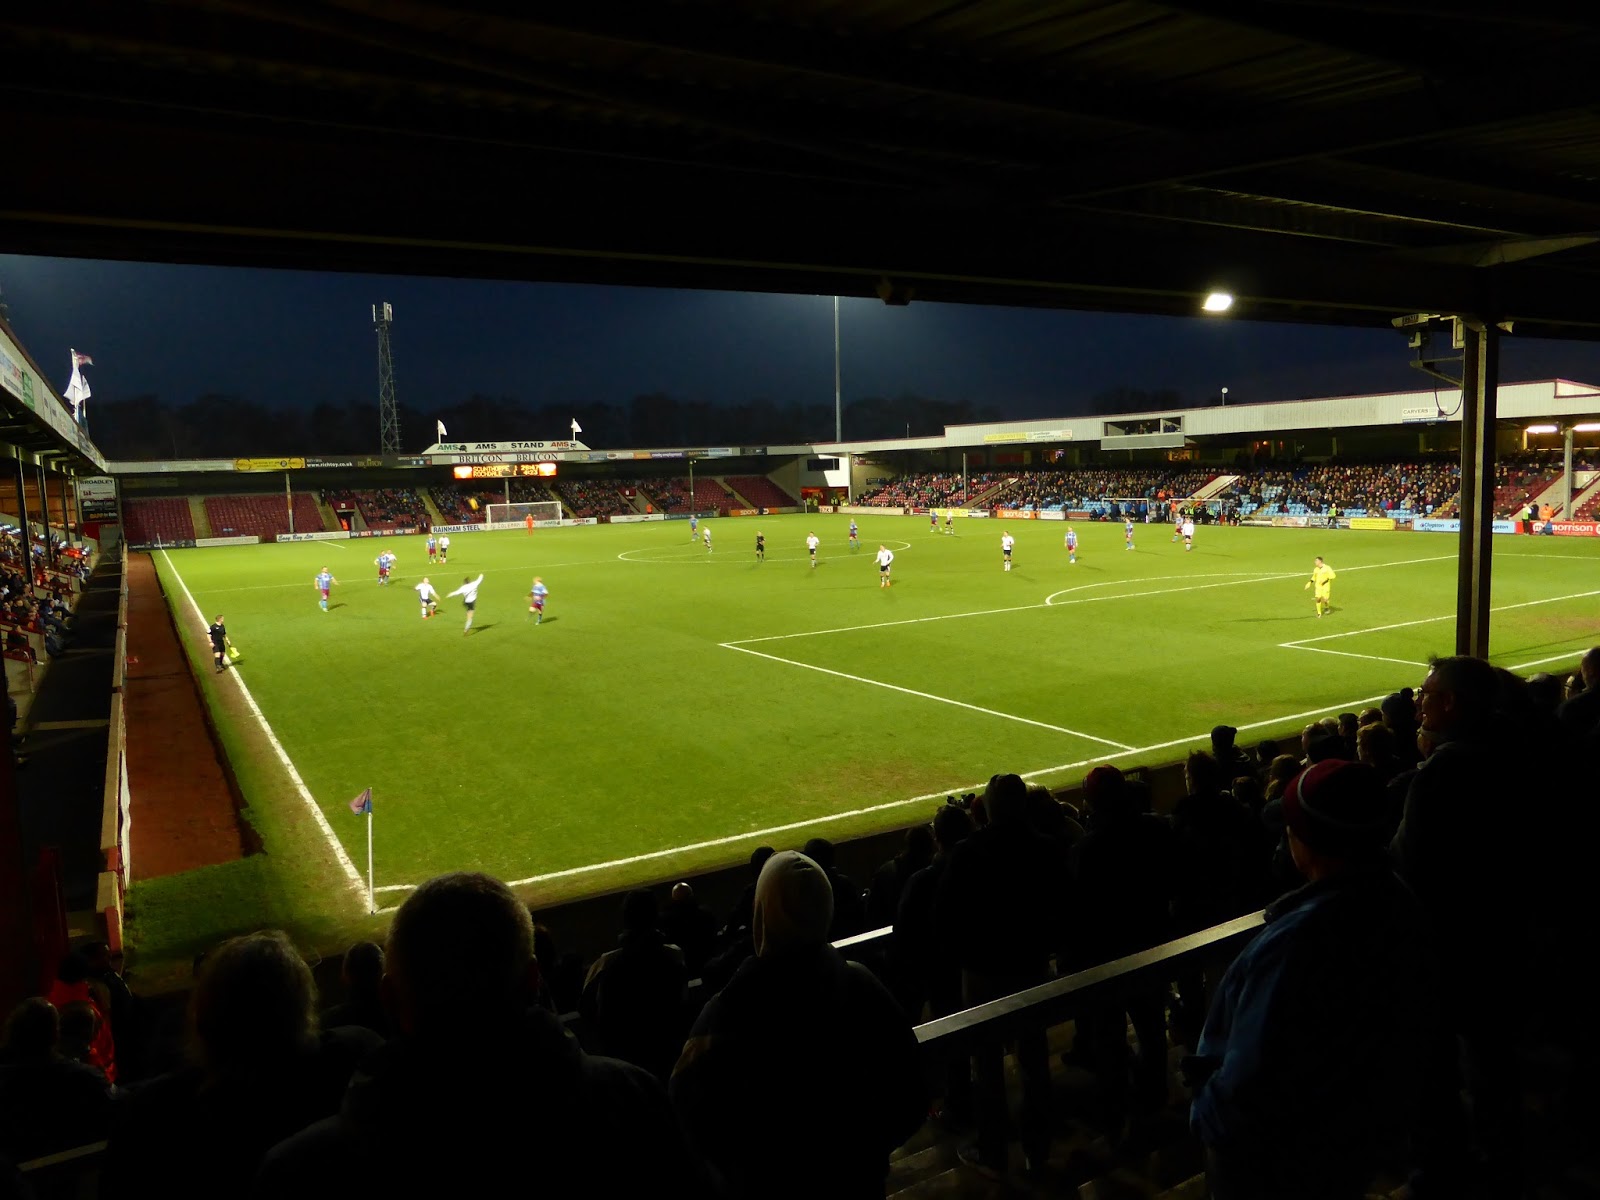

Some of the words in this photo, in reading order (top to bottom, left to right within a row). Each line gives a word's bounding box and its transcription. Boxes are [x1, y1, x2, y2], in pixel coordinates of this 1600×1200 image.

[459, 454, 502, 463] BRITCON
[516, 452, 558, 461] BRITCON
[433, 525, 462, 533] RAINHAM
[462, 524, 481, 532] STEEL
